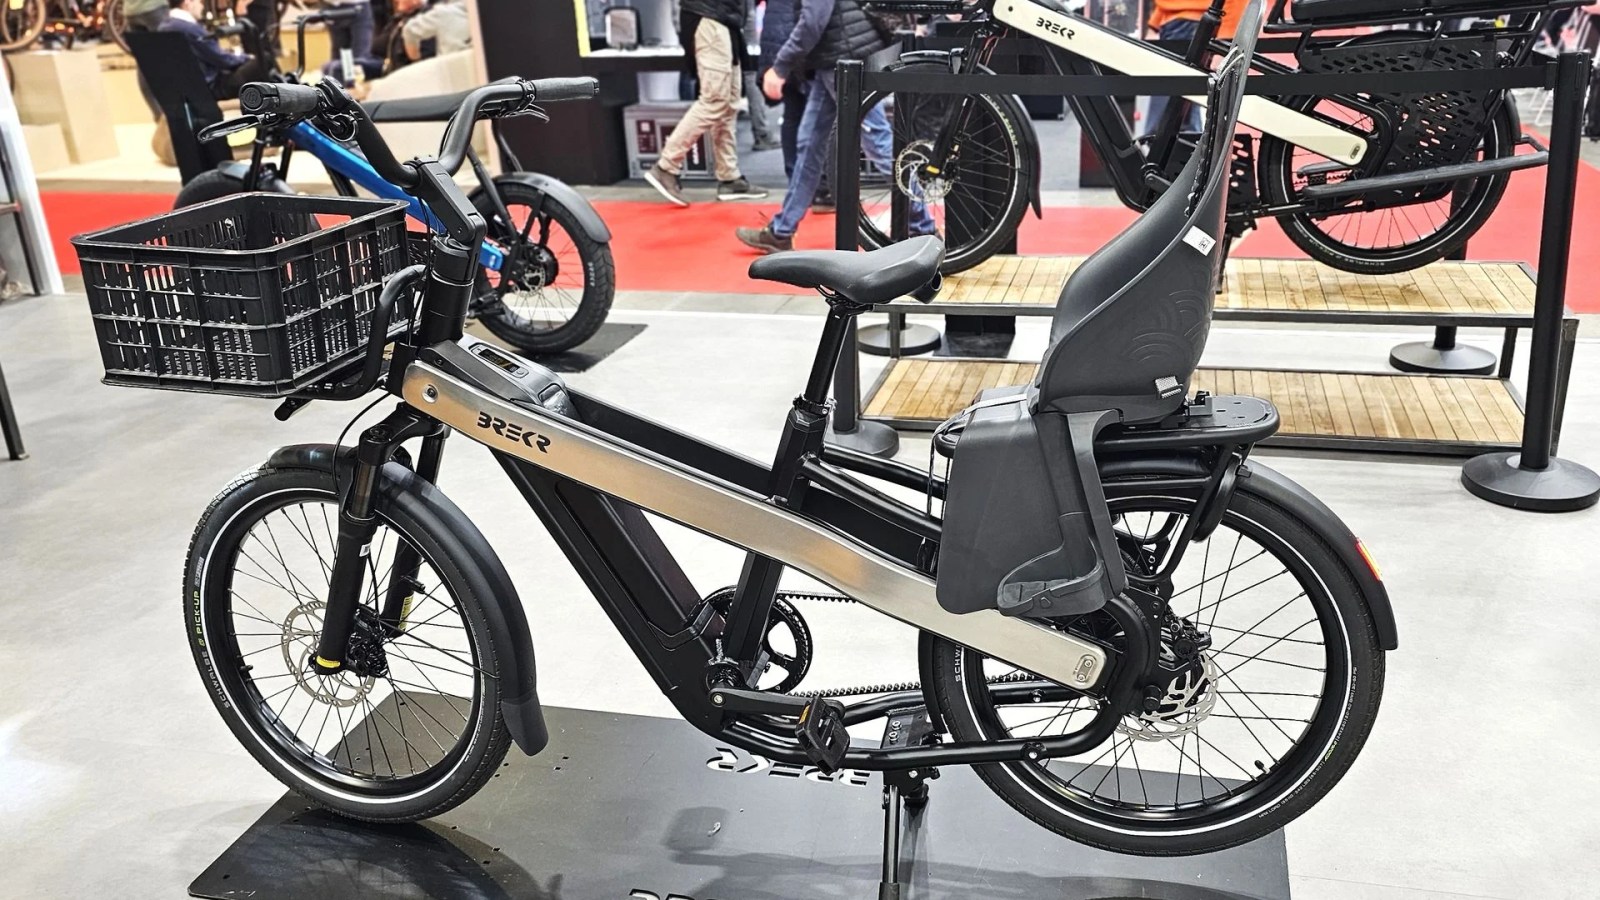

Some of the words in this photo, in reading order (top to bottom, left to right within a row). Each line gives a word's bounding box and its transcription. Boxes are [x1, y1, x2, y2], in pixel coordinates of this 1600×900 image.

[1036, 17, 1075, 40] BREKR
[477, 411, 551, 454] BREKR
[193, 590, 203, 634] PICK-UP
[202, 650, 231, 708] SCHWALBE
